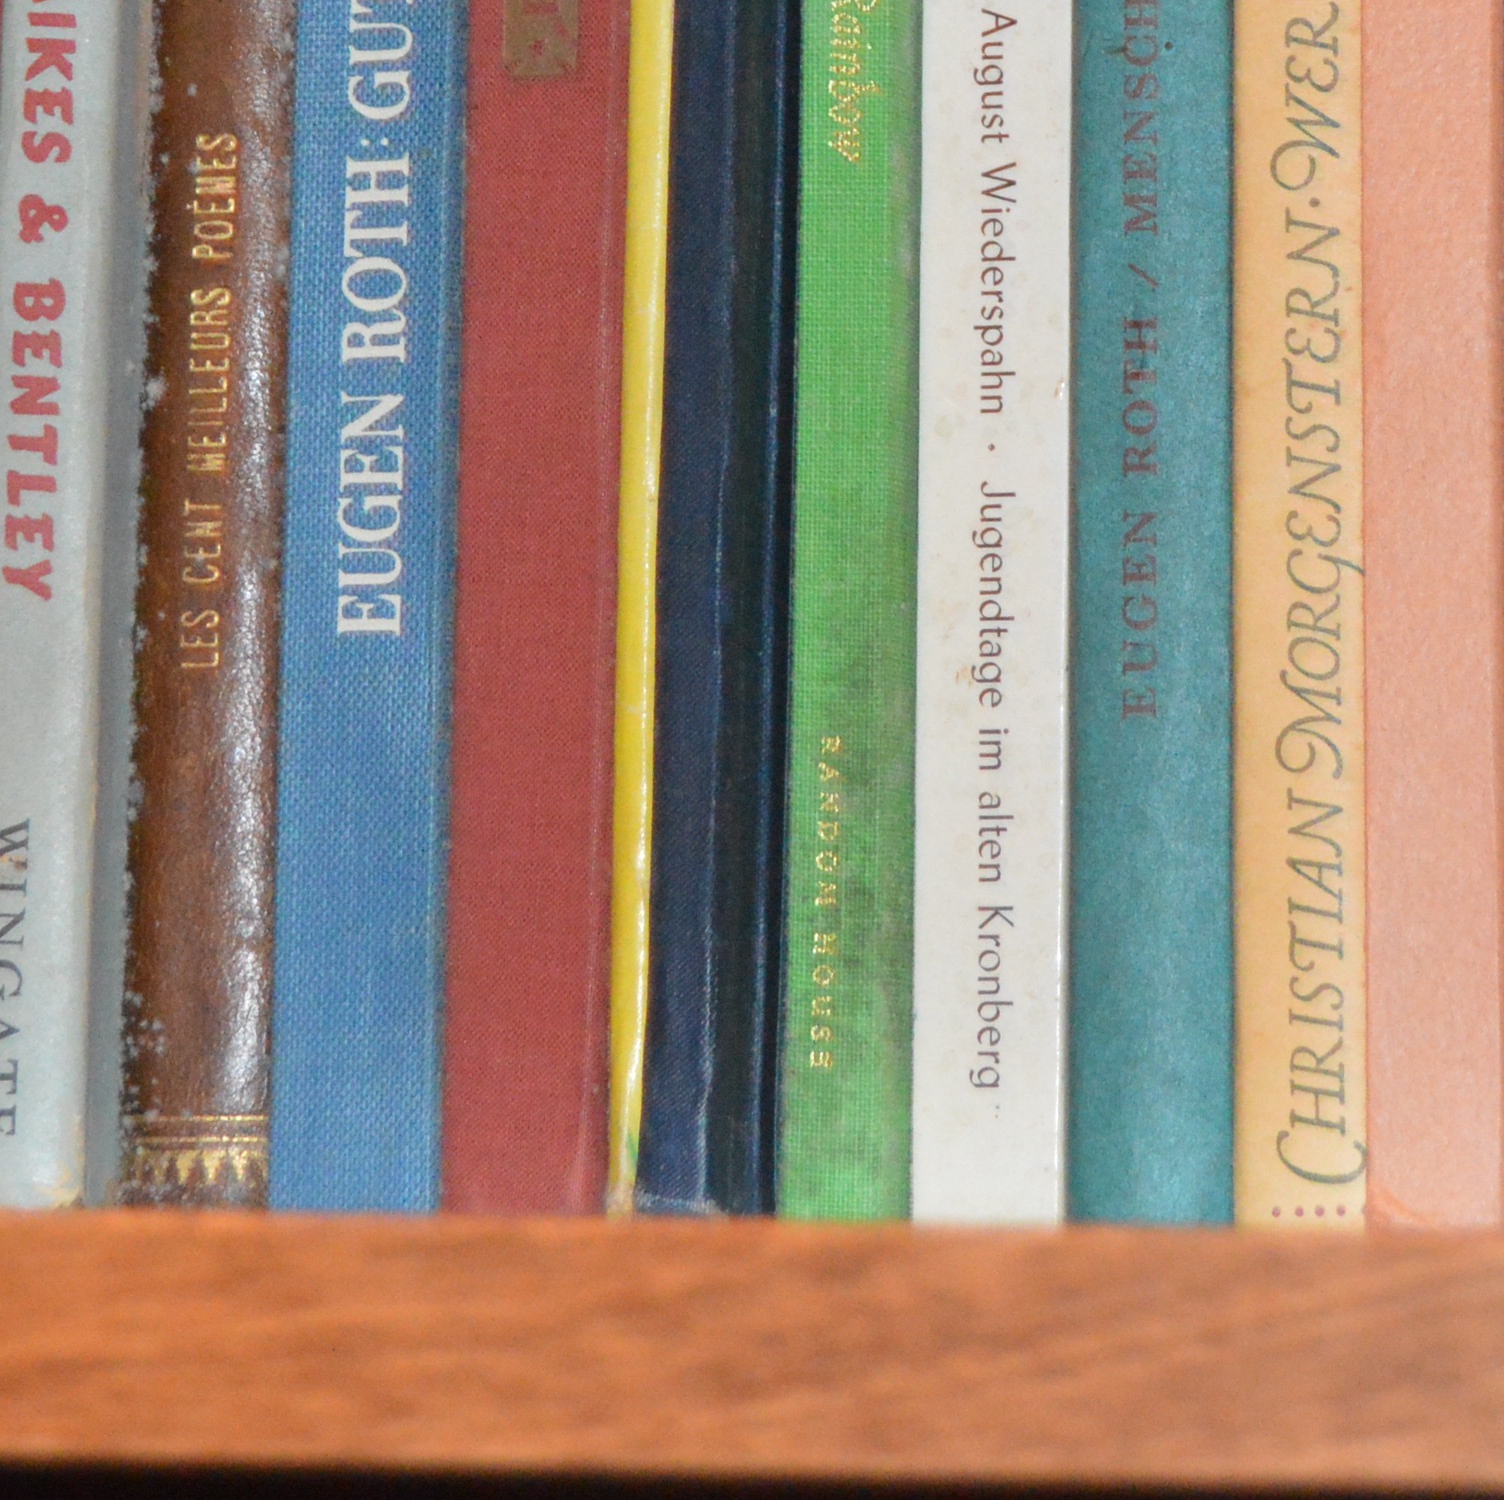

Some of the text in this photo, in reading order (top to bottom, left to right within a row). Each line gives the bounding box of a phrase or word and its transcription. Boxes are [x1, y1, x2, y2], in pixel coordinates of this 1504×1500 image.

[973, 7, 1018, 144] August
[1269, 1, 1341, 193] WER
[17, 192, 69, 244] &
[340, 136, 412, 363] ROTH:
[973, 161, 1018, 414] Wiederspahn
[3, 277, 66, 602] BENTLEY
[186, 287, 232, 472] MEILLEURS
[1121, 313, 1160, 477] ROTH
[183, 499, 223, 586] CENT
[336, 392, 406, 637] EUGEN
[973, 481, 1017, 708] Jugendtage
[179, 607, 220, 672] LES
[1121, 510, 1158, 719] EUGEN
[977, 792, 1016, 885] alten
[978, 729, 1011, 772] im
[810, 735, 843, 1069] RANDOM HOUSE
[1276, 789, 1367, 1185] CHRISTIAN
[969, 905, 1016, 1089] Kronberg
